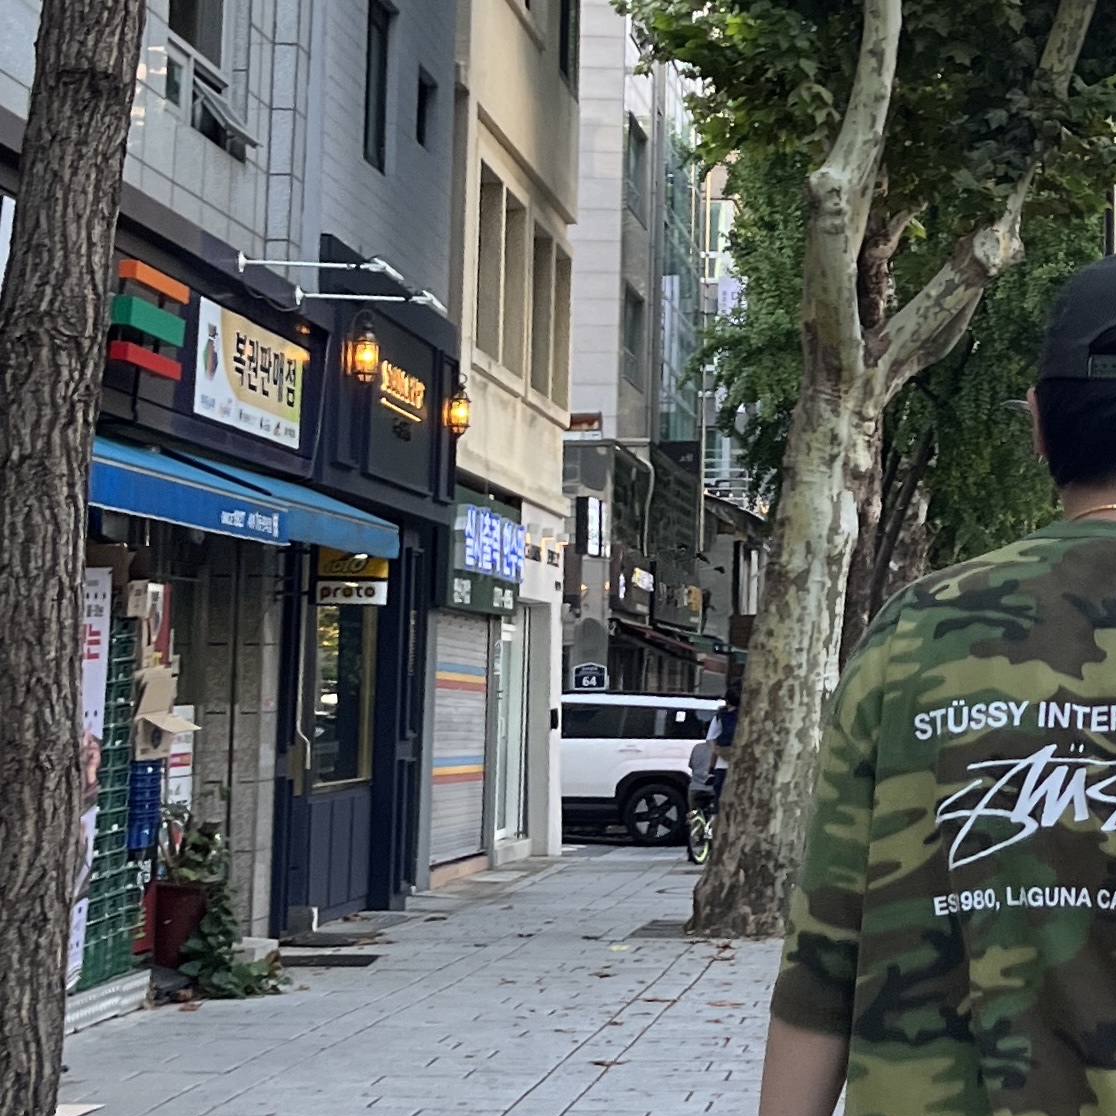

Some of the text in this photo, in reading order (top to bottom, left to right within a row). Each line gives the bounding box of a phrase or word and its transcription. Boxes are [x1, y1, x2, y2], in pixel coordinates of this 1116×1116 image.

[233, 331, 297, 408] 복권판매점
[320, 586, 376, 600] proto
[582, 676, 597, 687] 64
[914, 699, 1029, 740] STÜSSY
[1006, 886, 1093, 907] LAGUNA
